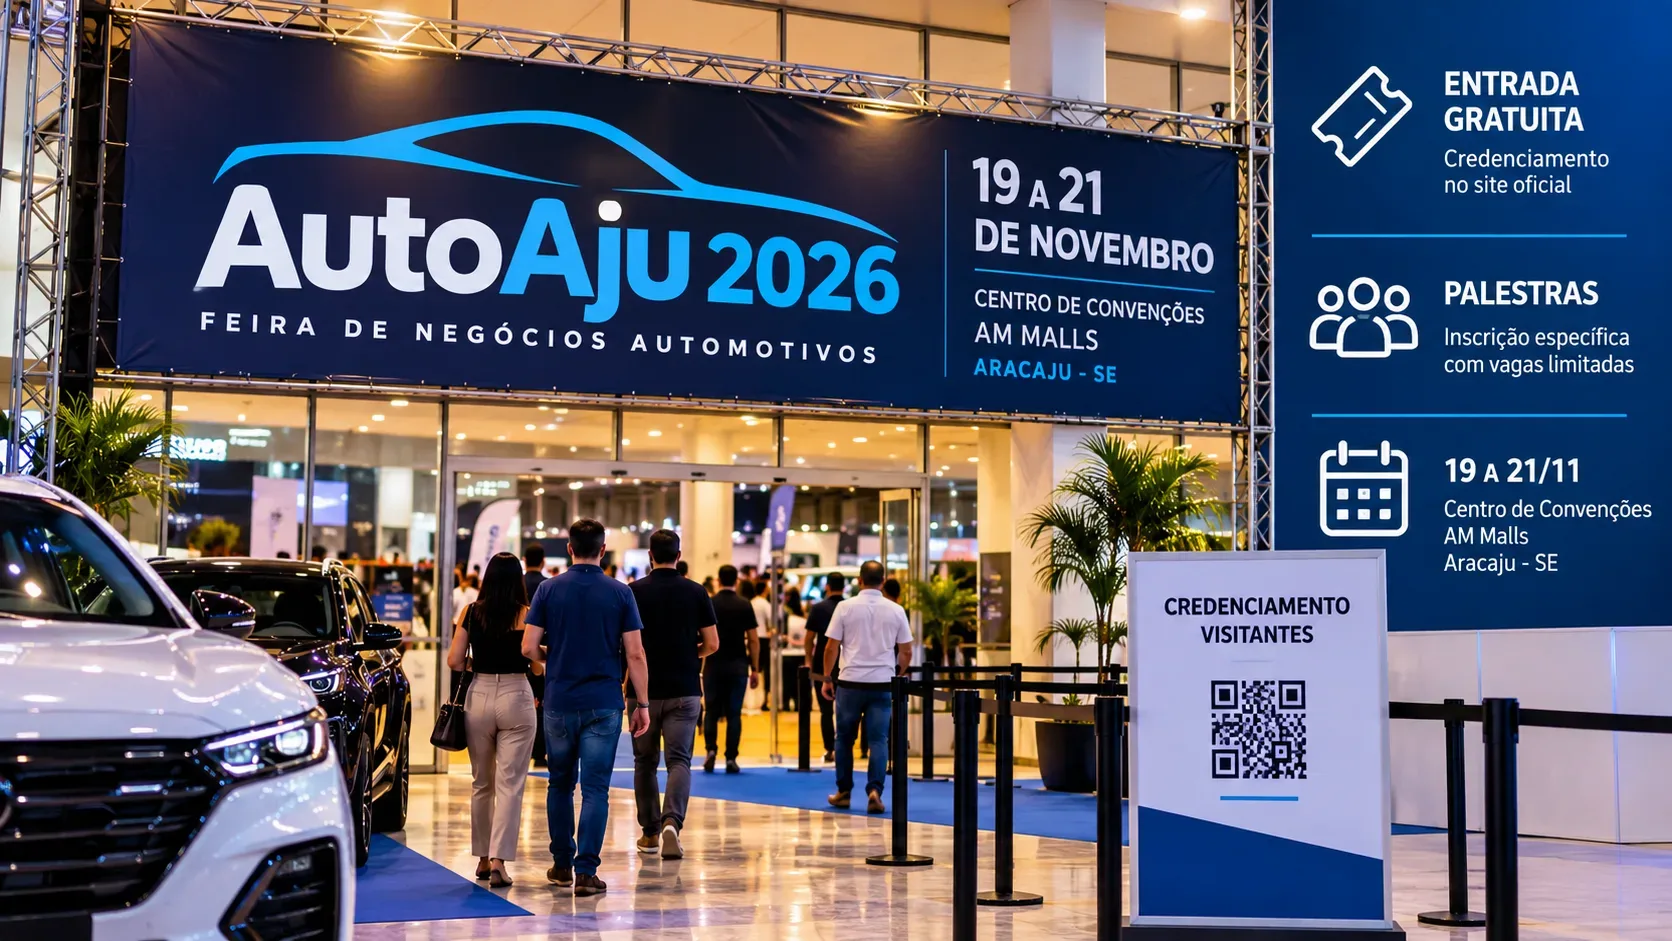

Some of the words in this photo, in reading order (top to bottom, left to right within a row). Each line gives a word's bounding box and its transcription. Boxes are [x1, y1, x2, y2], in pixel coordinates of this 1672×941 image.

[1444, 70, 1580, 96] ENTRADA
[1444, 106, 1585, 132] GRATUITA
[1444, 148, 1610, 168] Credenciamento
[972, 156, 1021, 205] 19
[1028, 179, 1051, 210] A
[1058, 166, 1102, 216] 21
[1444, 179, 1469, 194] no
[1474, 174, 1508, 194] site
[1513, 174, 1572, 194] oficial
[975, 217, 1020, 255] DE
[1030, 223, 1215, 275] NOVEMBRO
[707, 232, 900, 315] 2026
[1444, 280, 1599, 306] PALESTRAS
[974, 288, 1052, 313] CENTRO
[1057, 295, 1081, 315] DE
[1086, 297, 1205, 327] CONVENÇÕES
[200, 311, 316, 336] FEIRA
[344, 318, 388, 340] DE
[415, 321, 606, 351] NEGÓCIOS
[630, 333, 876, 364] AUTOMOTIVOS
[974, 321, 1012, 346] AM
[1021, 324, 1099, 351] MALLS
[1445, 327, 1530, 351] Inscrição
[1534, 326, 1630, 351] específica
[973, 357, 1072, 381] ARACAJU
[1093, 364, 1117, 384] SE
[1444, 359, 1484, 374] com
[1488, 358, 1544, 378] vagas
[1548, 354, 1635, 374] limitadas
[1445, 457, 1477, 483] 19
[1483, 463, 1500, 483] A
[1506, 457, 1580, 485] 21/11
[1444, 499, 1507, 518] Centro
[1511, 498, 1535, 518] de
[1539, 499, 1653, 523] Convenções
[1443, 526, 1474, 545] AM
[1480, 525, 1529, 545] Malls
[1443, 553, 1516, 577] Aracaju
[1535, 553, 1559, 572] SE
[1164, 596, 1351, 616] CREDENCIAMENTO
[1200, 625, 1314, 644] VISITANTES
